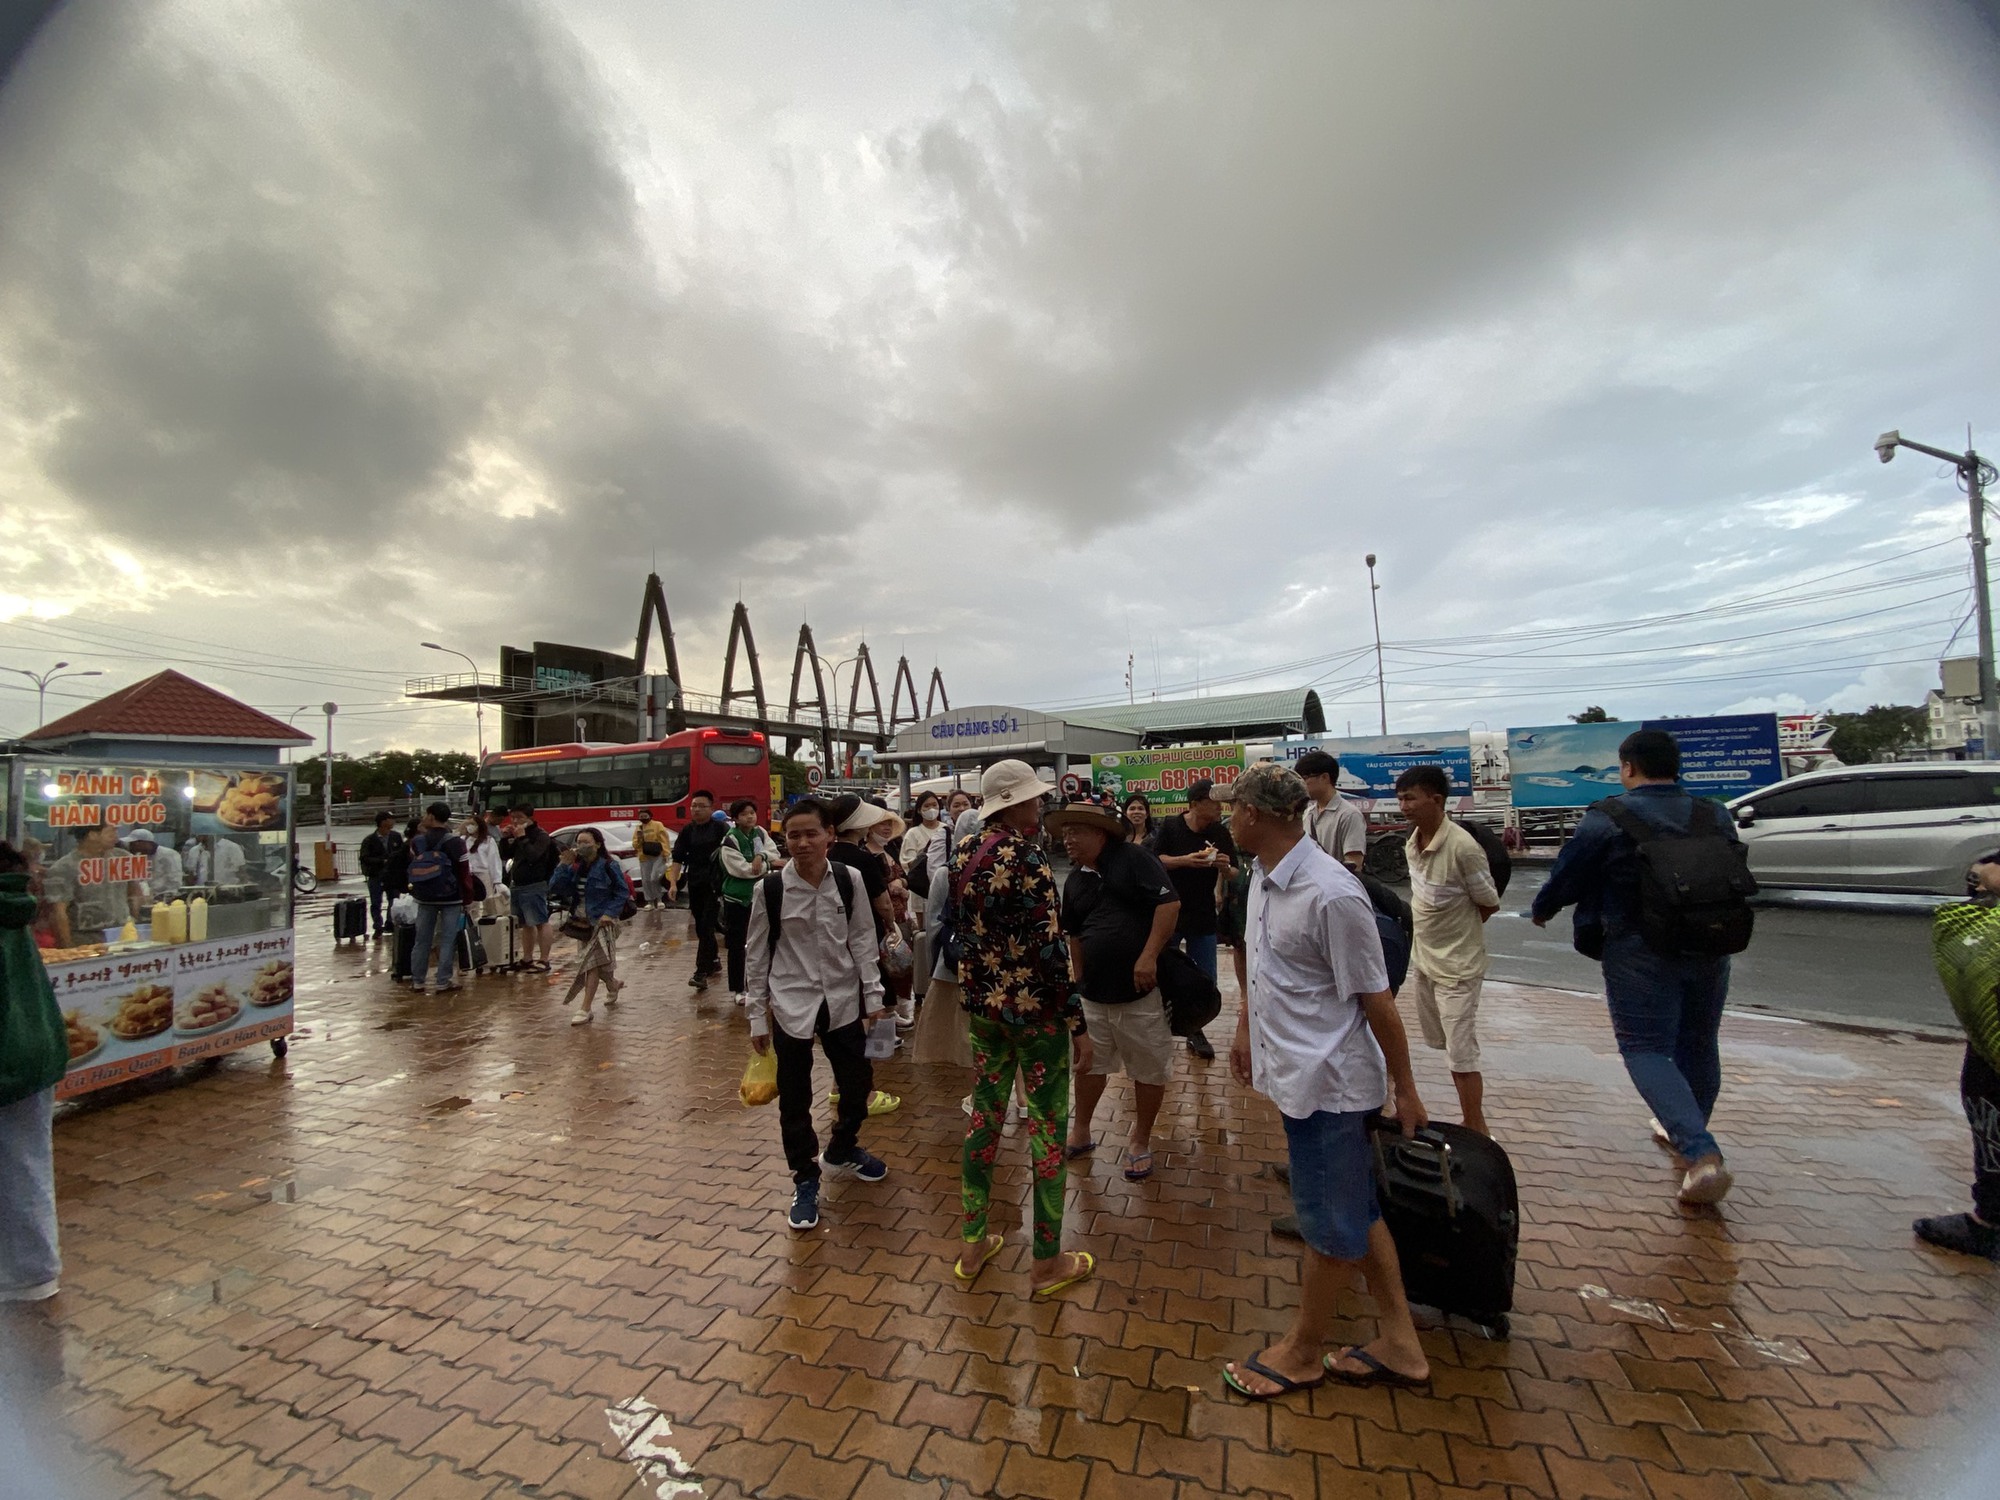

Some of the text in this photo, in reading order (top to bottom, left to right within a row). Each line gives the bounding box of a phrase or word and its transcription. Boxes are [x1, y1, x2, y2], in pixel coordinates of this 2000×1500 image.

[992, 712, 1008, 734] SỐ
[1011, 717, 1019, 732] 1
[1124, 754, 1150, 766] TAXI
[57, 769, 161, 796] BÁNH CÁ
[810, 772, 818, 781] 40
[1160, 767, 1186, 791] 68
[48, 797, 167, 827] HÀN QUỐC
[79, 857, 104, 885] SU
